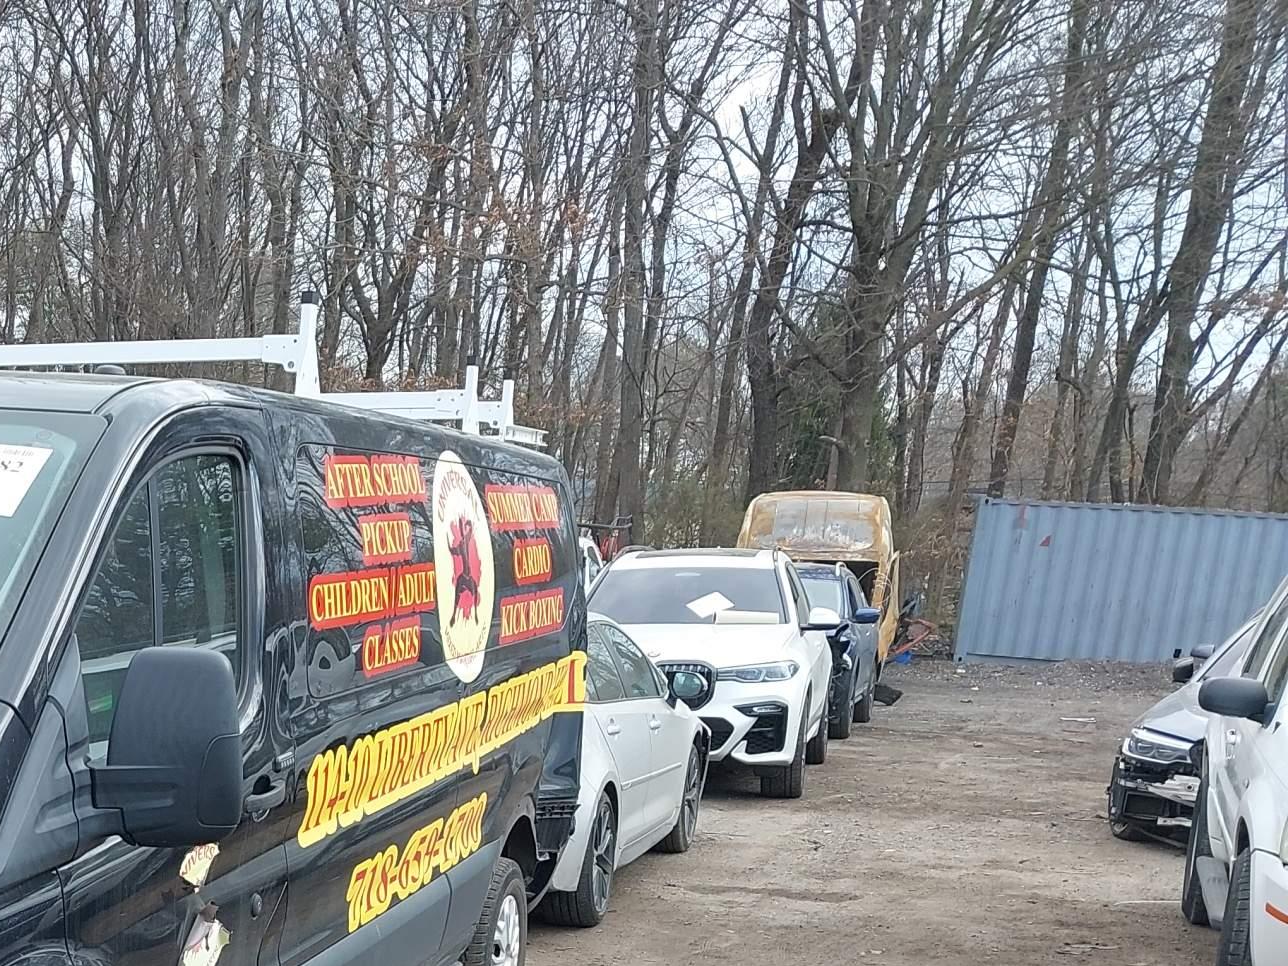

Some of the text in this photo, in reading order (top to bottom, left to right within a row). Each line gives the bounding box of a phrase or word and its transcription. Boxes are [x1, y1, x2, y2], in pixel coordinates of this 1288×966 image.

[327, 463, 425, 499] AFTER SCHOOL
[488, 492, 559, 524] SUMMER CAMP
[361, 520, 410, 557] PICKUP
[515, 544, 550, 579] CARDIO
[312, 576, 389, 622] CHILDREN
[398, 570, 436, 607] ADULT
[500, 594, 563, 638] KICK BOXING
[365, 625, 419, 671] CLASSES
[303, 744, 371, 833] 114-10
[368, 712, 455, 802] LIBERTY
[353, 801, 485, 918] 718-659-1700
